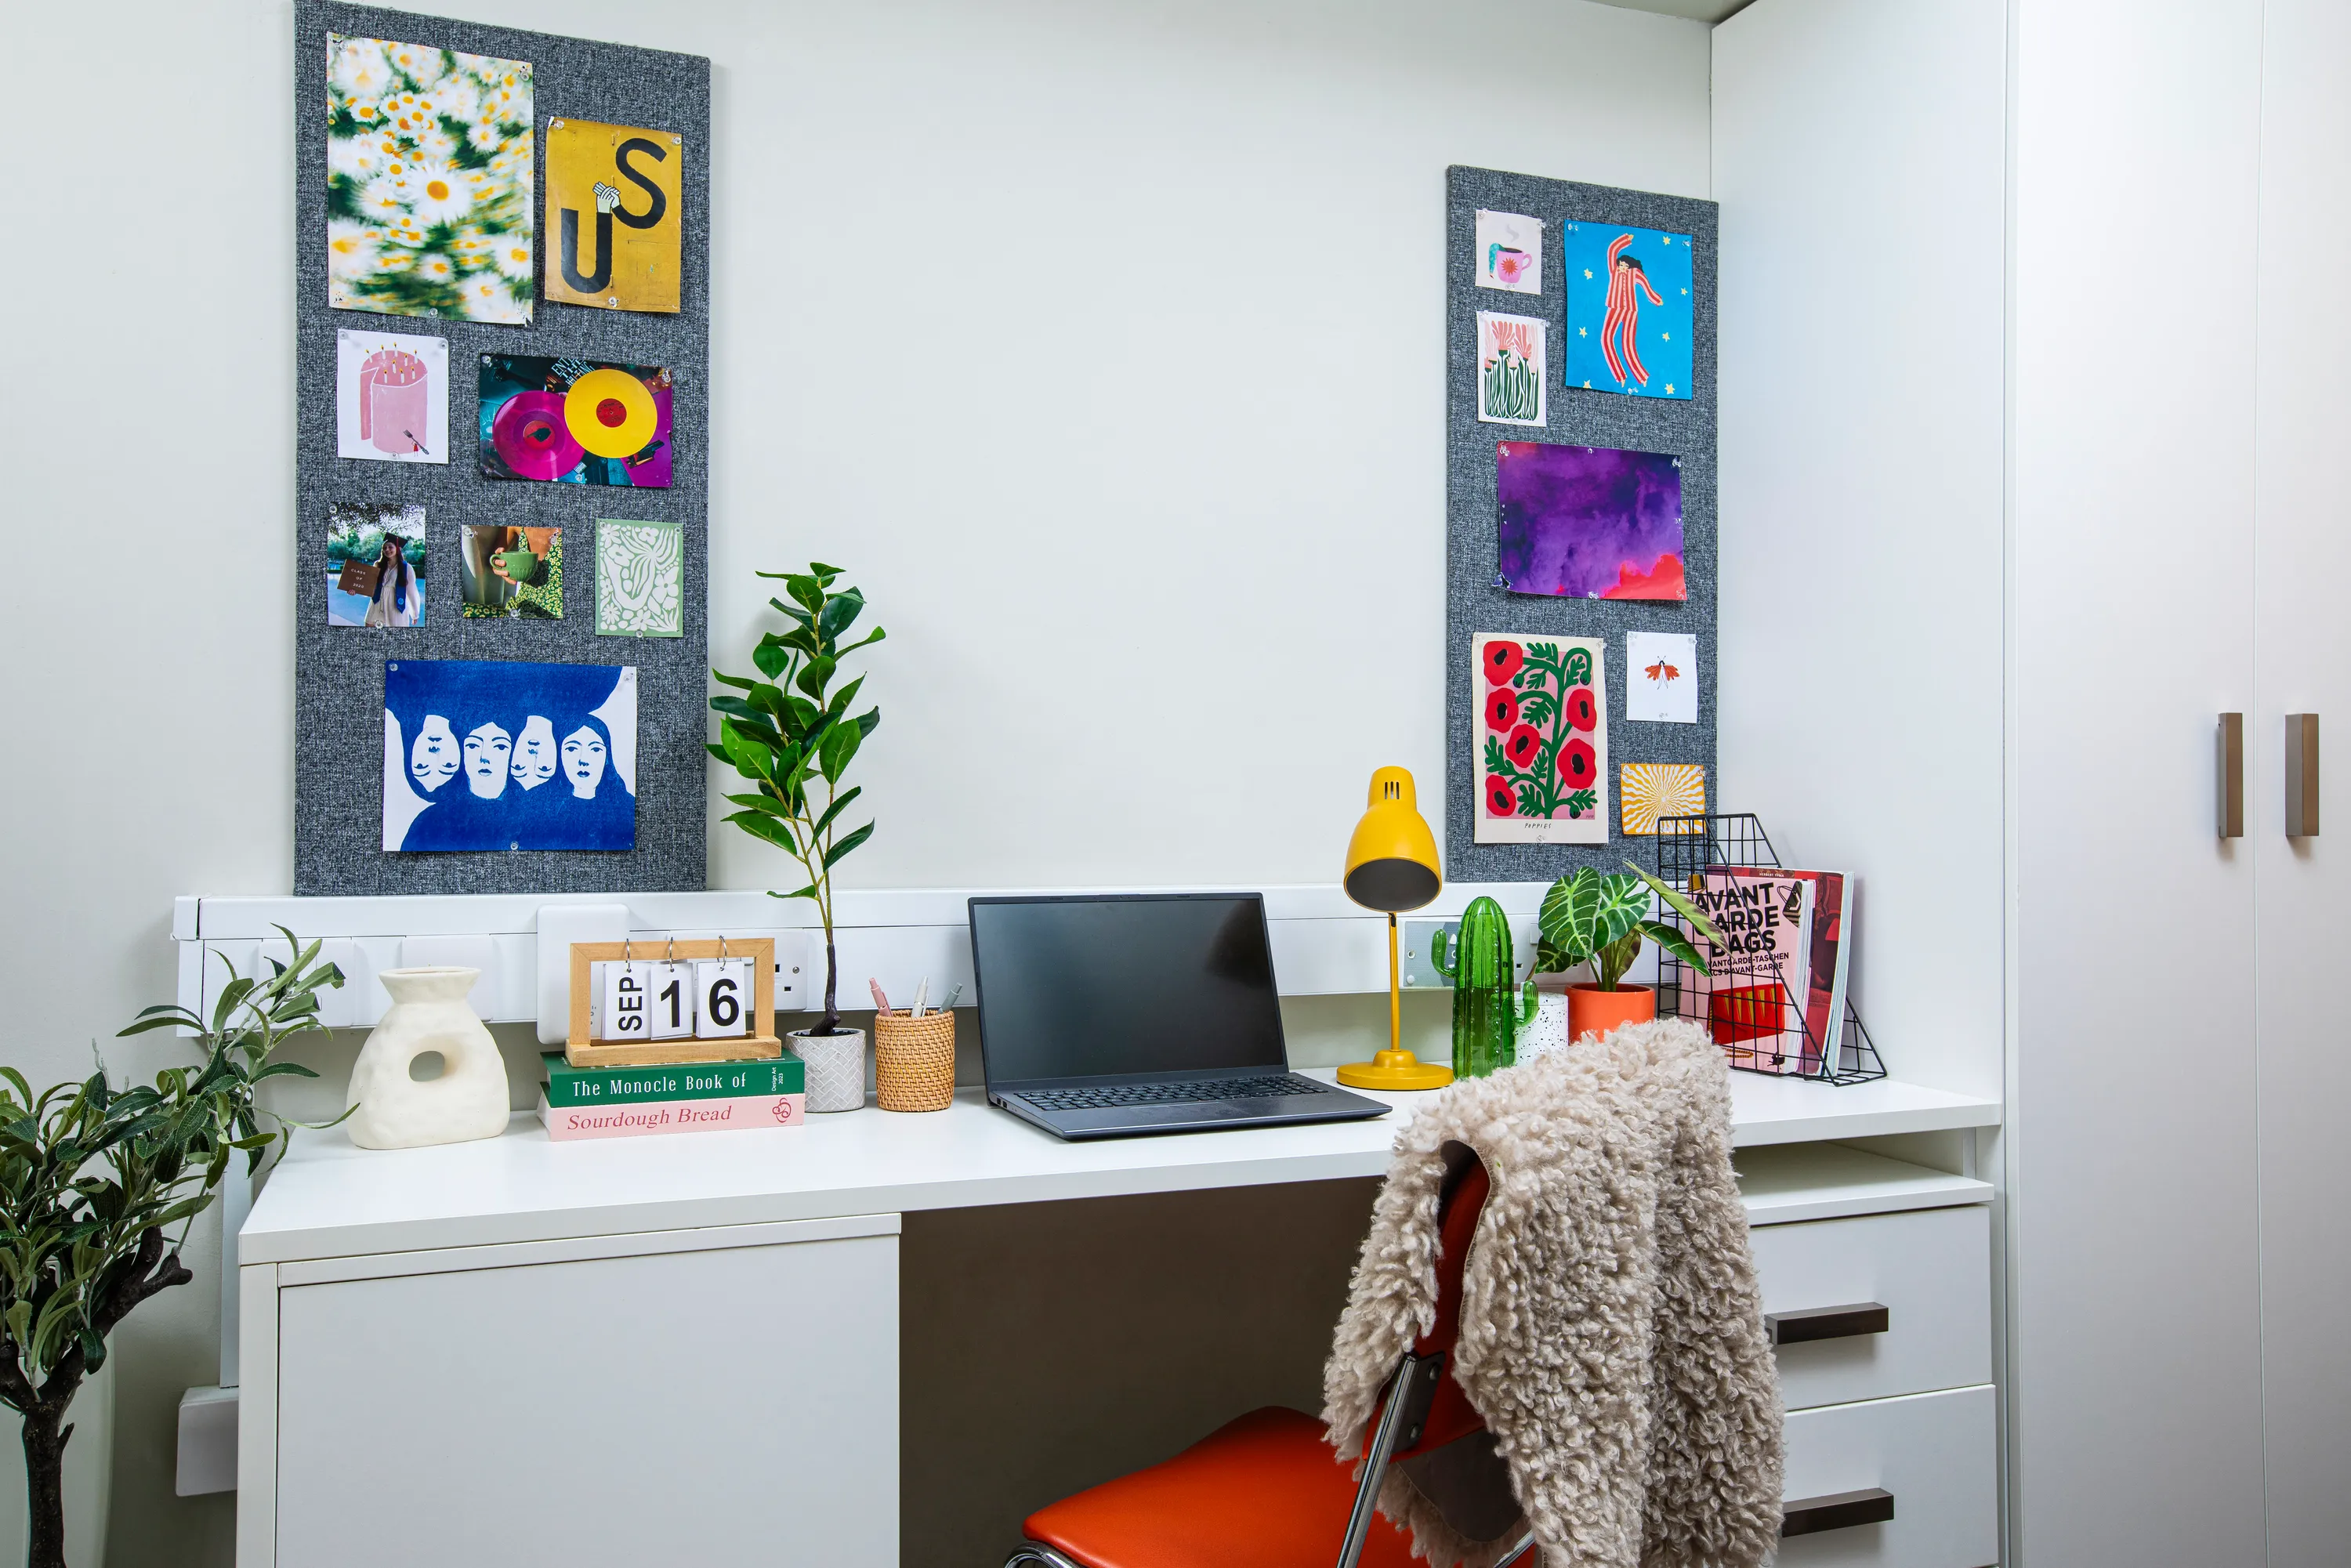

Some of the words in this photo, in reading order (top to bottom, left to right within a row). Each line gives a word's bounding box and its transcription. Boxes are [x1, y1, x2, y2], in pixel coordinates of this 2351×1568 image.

[1694, 882, 1774, 913] AVANT
[1694, 905, 1780, 936] ARDE
[1707, 951, 1789, 969] VANTGARDE-TASCHEN
[618, 976, 643, 1031] SEP
[572, 1081, 601, 1096] The
[610, 1076, 676, 1095] Monocle
[686, 1074, 723, 1090] Book
[732, 1071, 746, 1088] of
[567, 1109, 670, 1131] Sourdough
[677, 1105, 733, 1124] Bread
